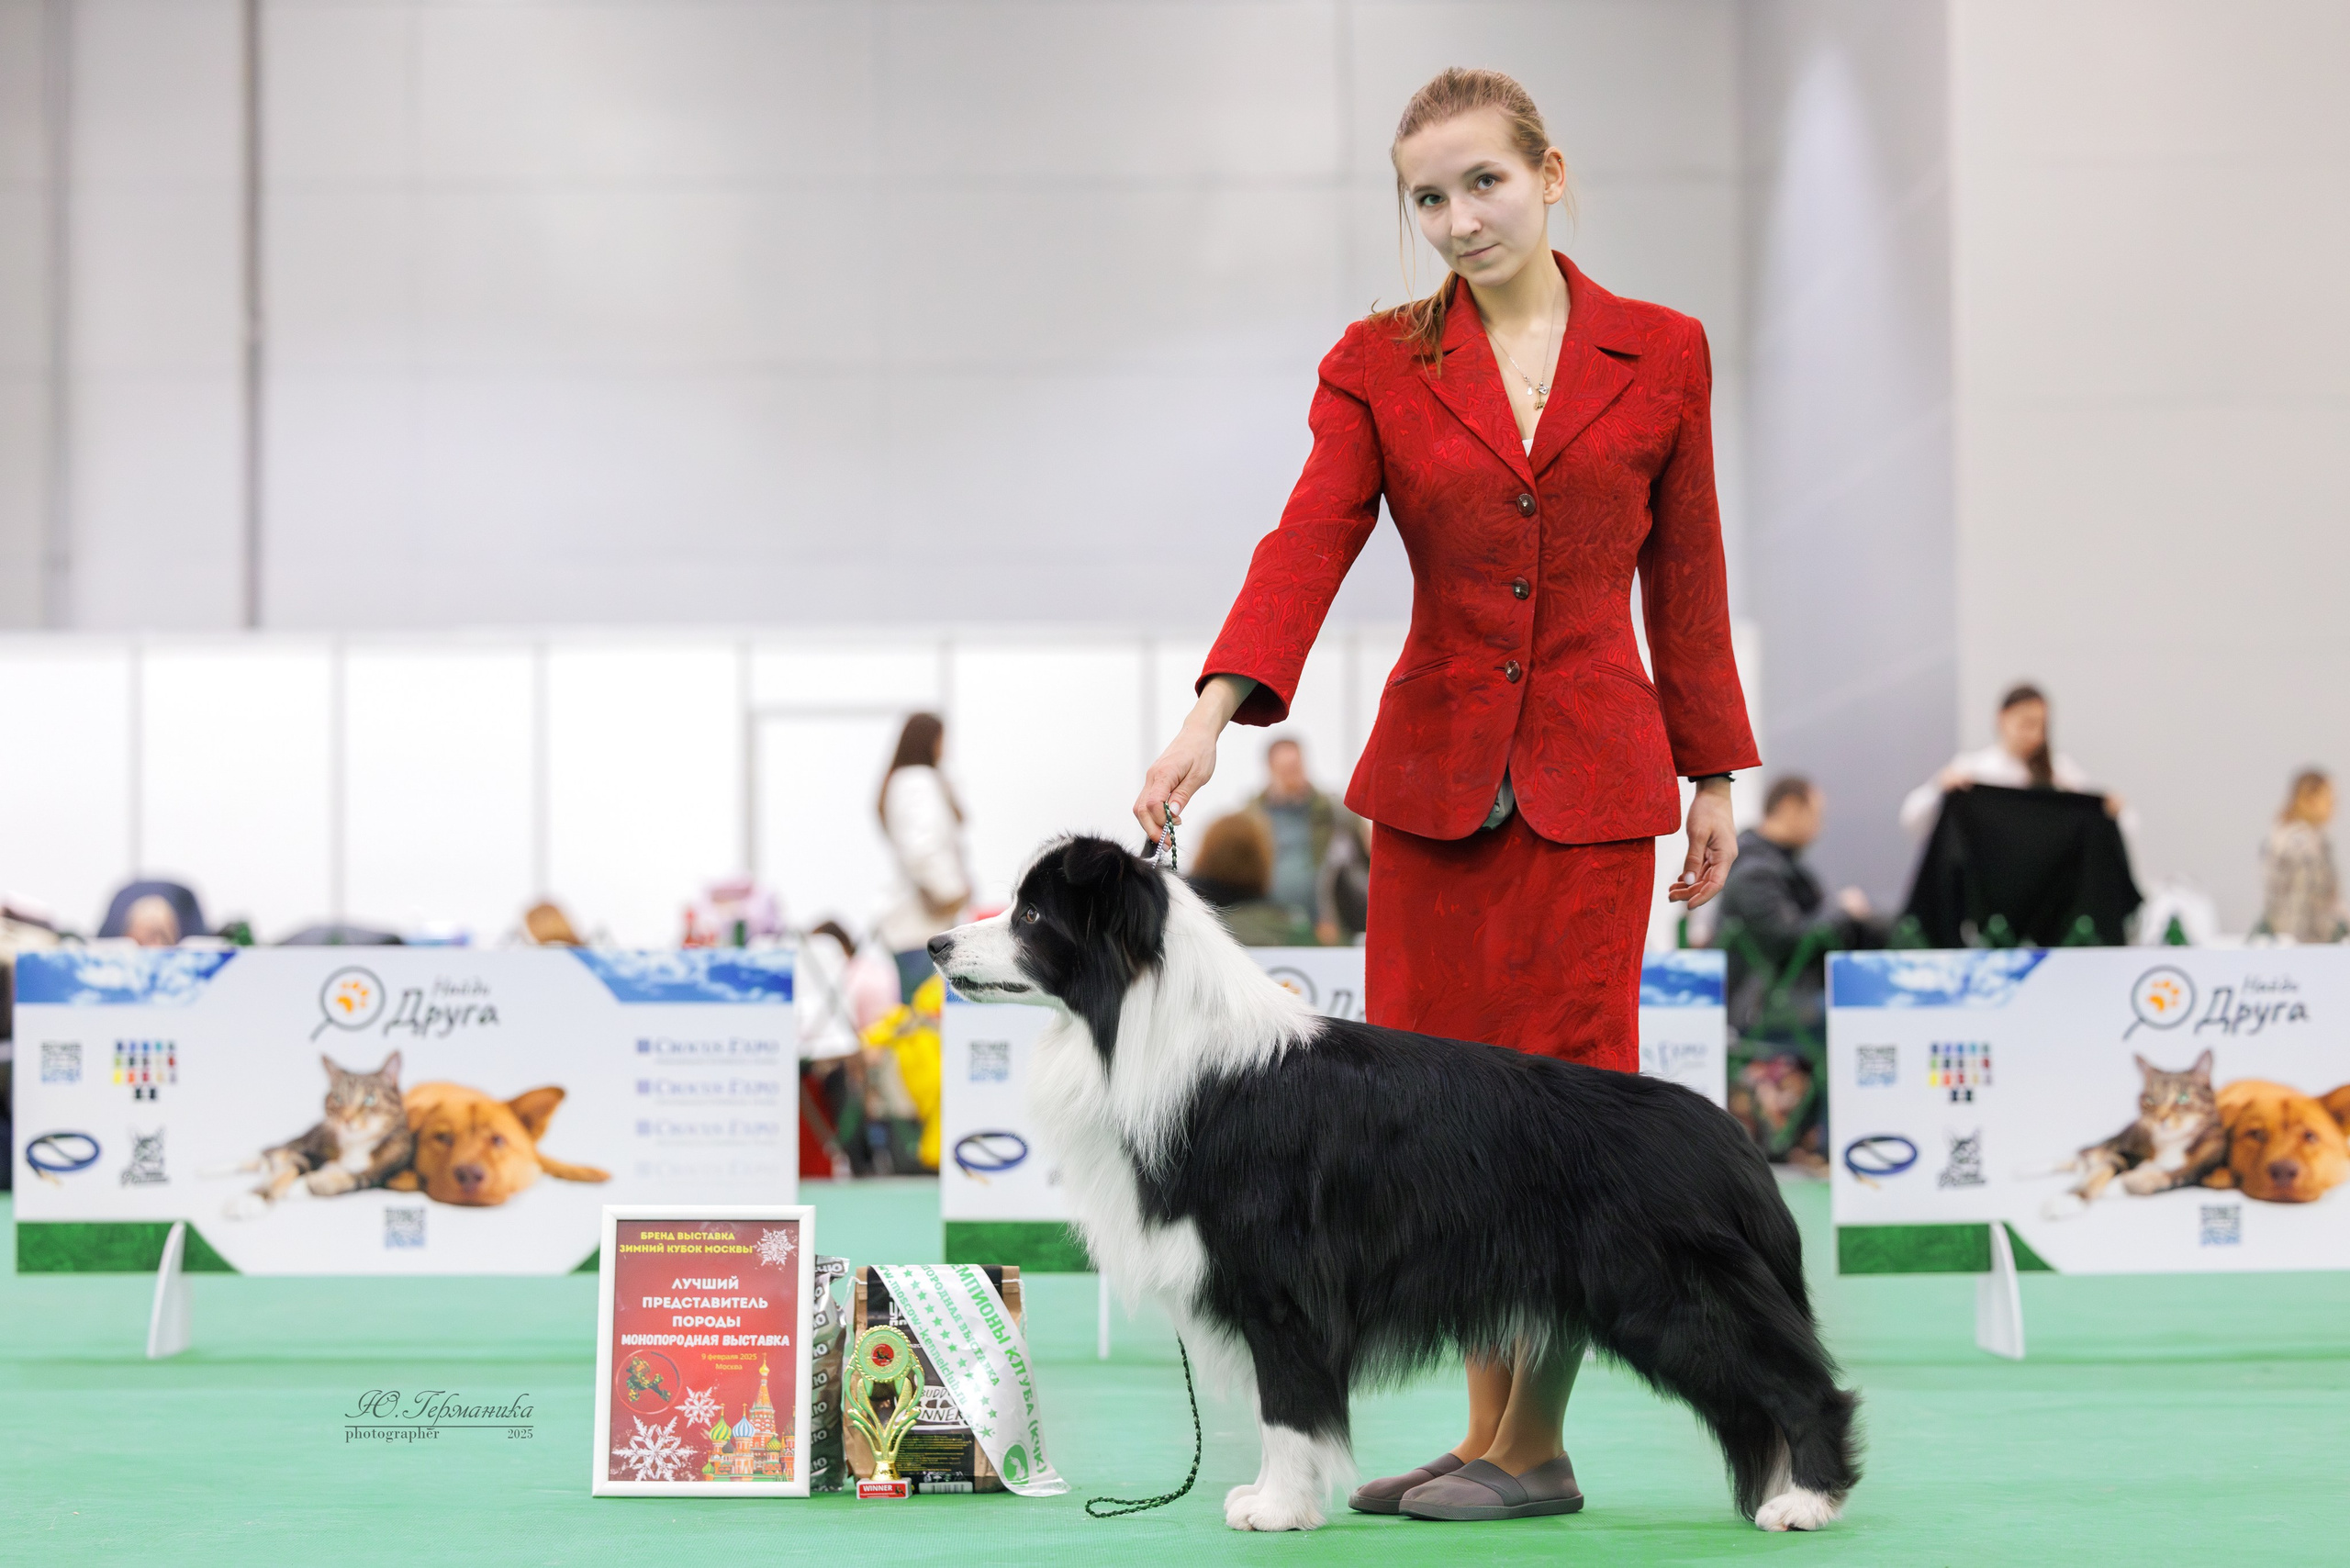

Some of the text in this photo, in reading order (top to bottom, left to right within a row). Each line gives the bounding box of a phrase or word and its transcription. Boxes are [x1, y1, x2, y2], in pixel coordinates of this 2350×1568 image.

[382, 988, 499, 1038] Друга
[2193, 986, 2311, 1036] Друга
[641, 1232, 735, 1240] БРЕНД ВЫСТАВКА
[620, 1243, 753, 1254] ЗИМНИЙ КУБОК МОСКВЫ
[671, 1275, 739, 1290] ЛУЧШИЙ
[642, 1296, 768, 1309] ПРЕДСТАВИТЕЛЬ
[672, 1316, 741, 1328] ПОРОДЫ
[621, 1334, 790, 1348] МОНОПОРОДНАЯ ВЫСТАВКА
[958, 1322, 1000, 1386] ВЫСТАВКА
[1004, 1345, 1035, 1417] КЛУБА
